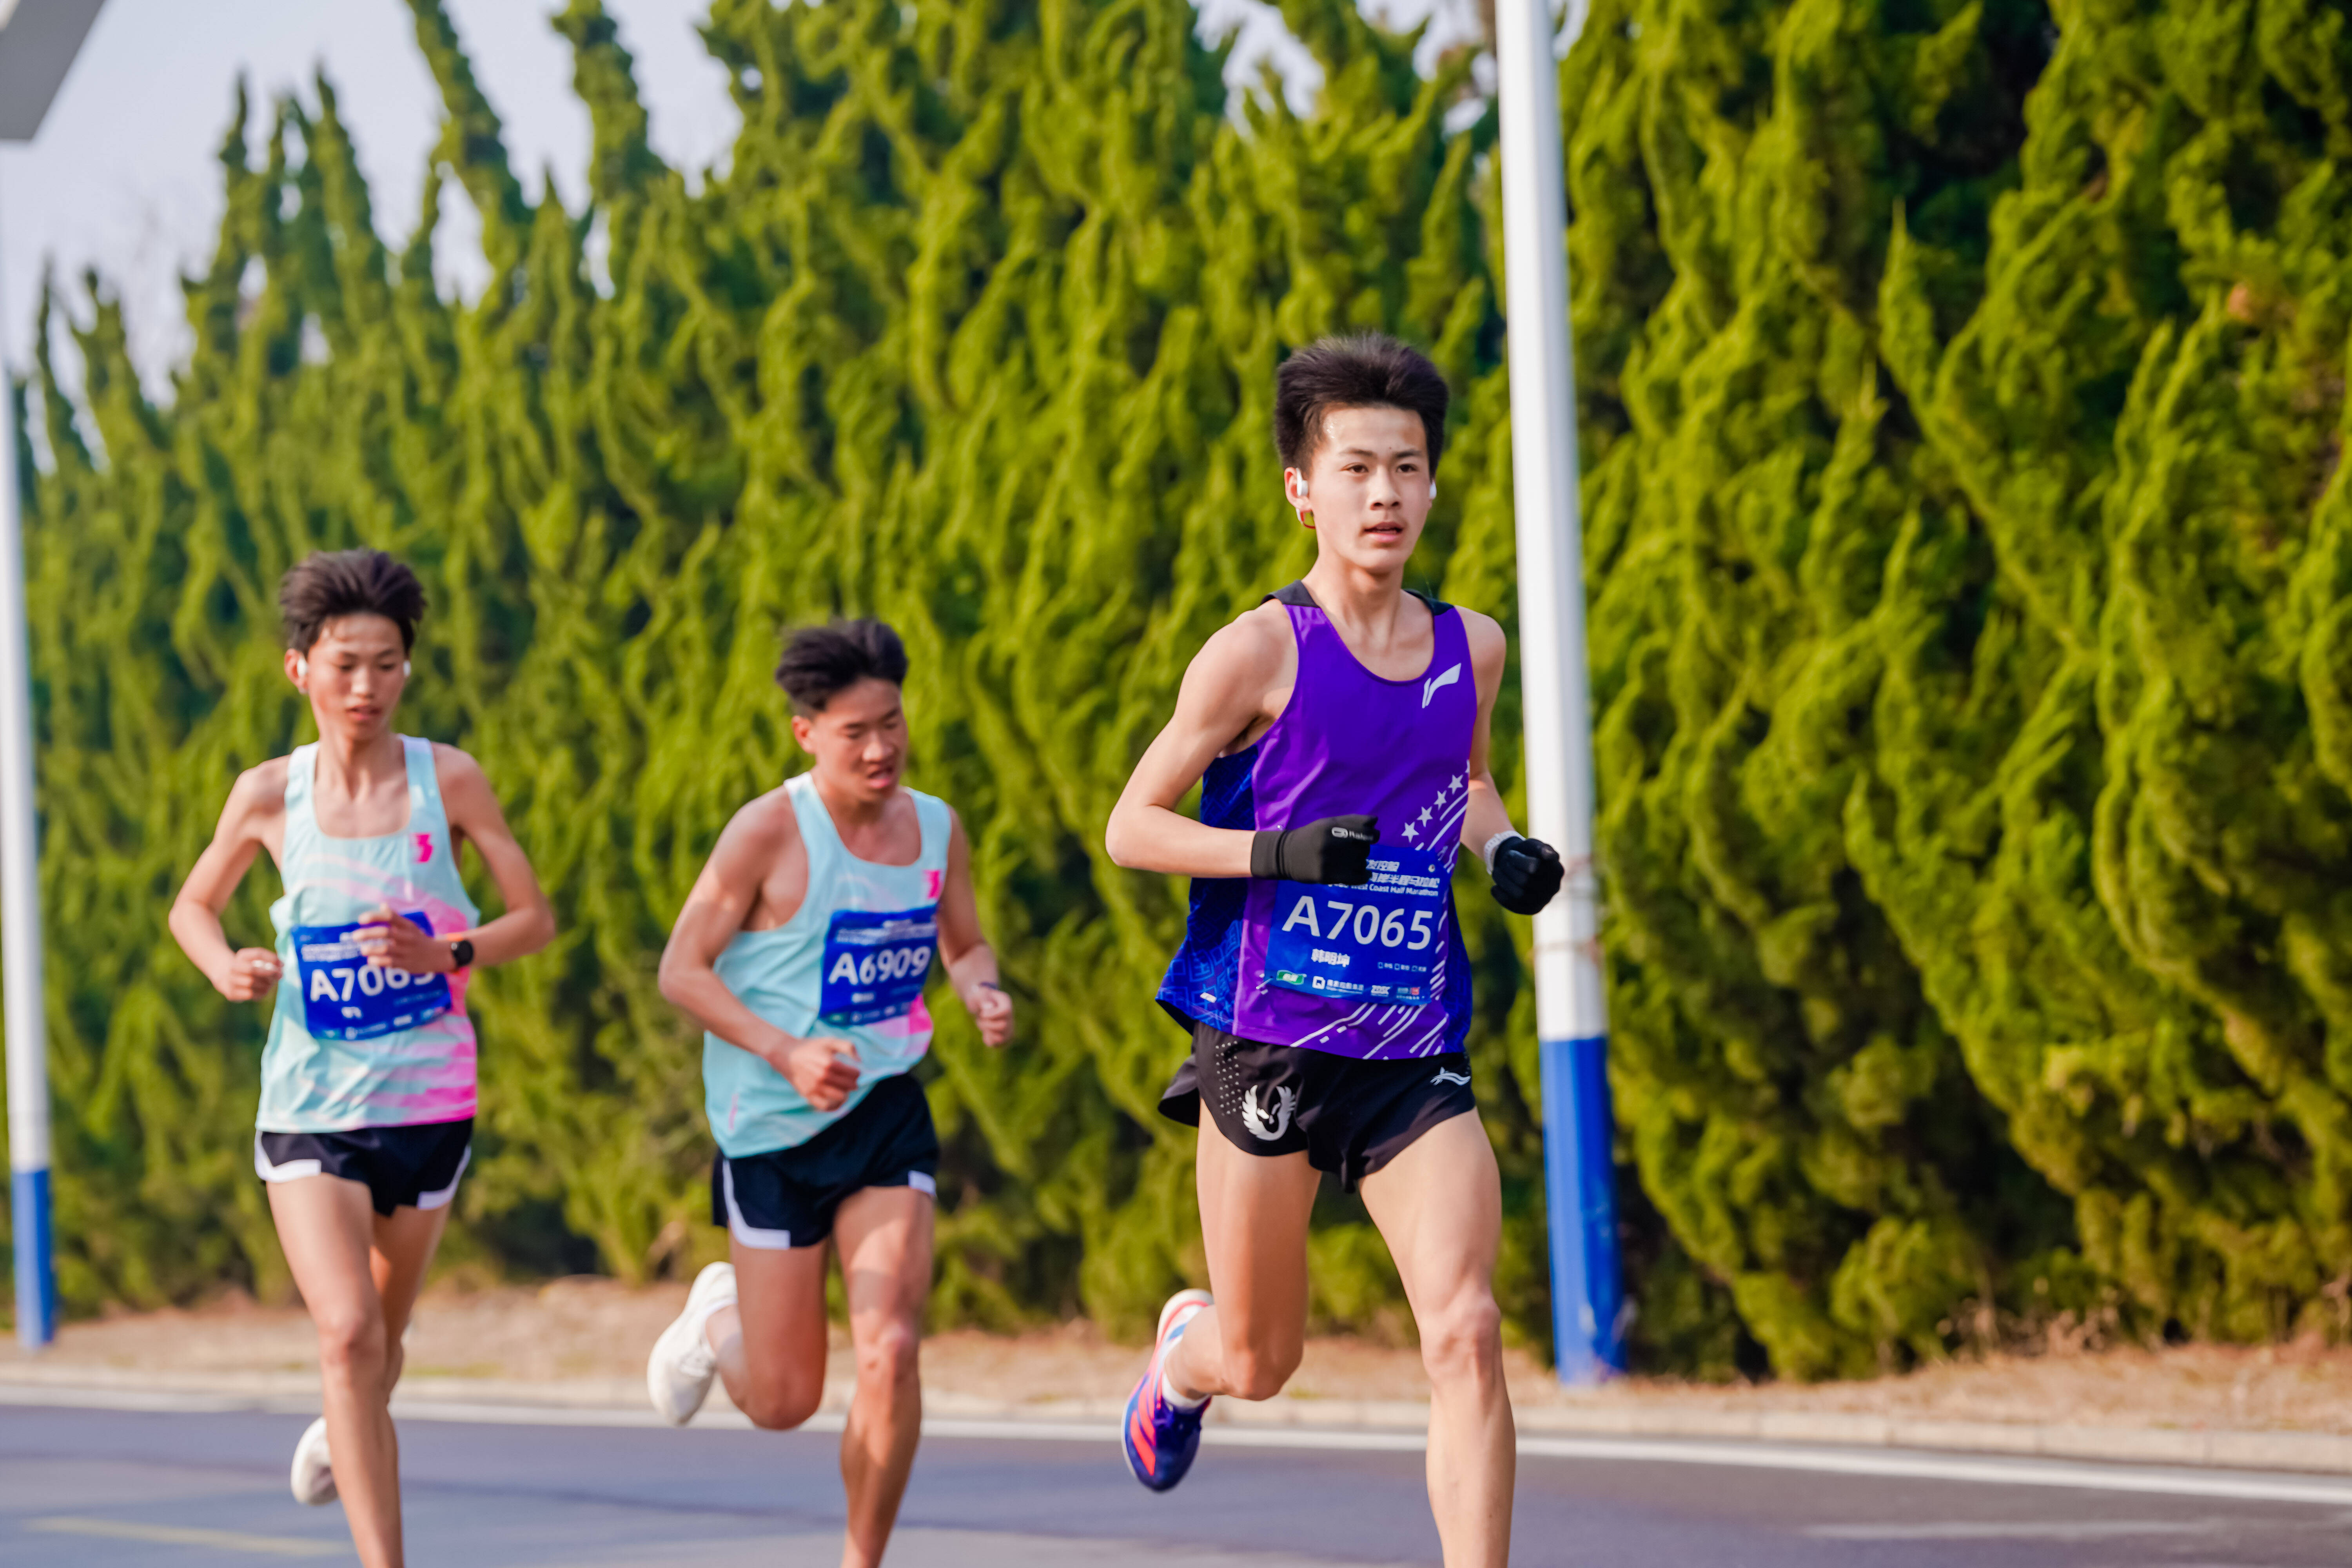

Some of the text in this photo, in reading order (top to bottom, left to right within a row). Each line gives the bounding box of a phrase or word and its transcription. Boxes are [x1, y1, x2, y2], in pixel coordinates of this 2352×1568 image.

[1369, 884, 1389, 893] Coast
[1390, 886, 1405, 894] Half
[1405, 887, 1438, 897] Marathon
[1282, 895, 1433, 950] A7065
[828, 946, 931, 985] A6909
